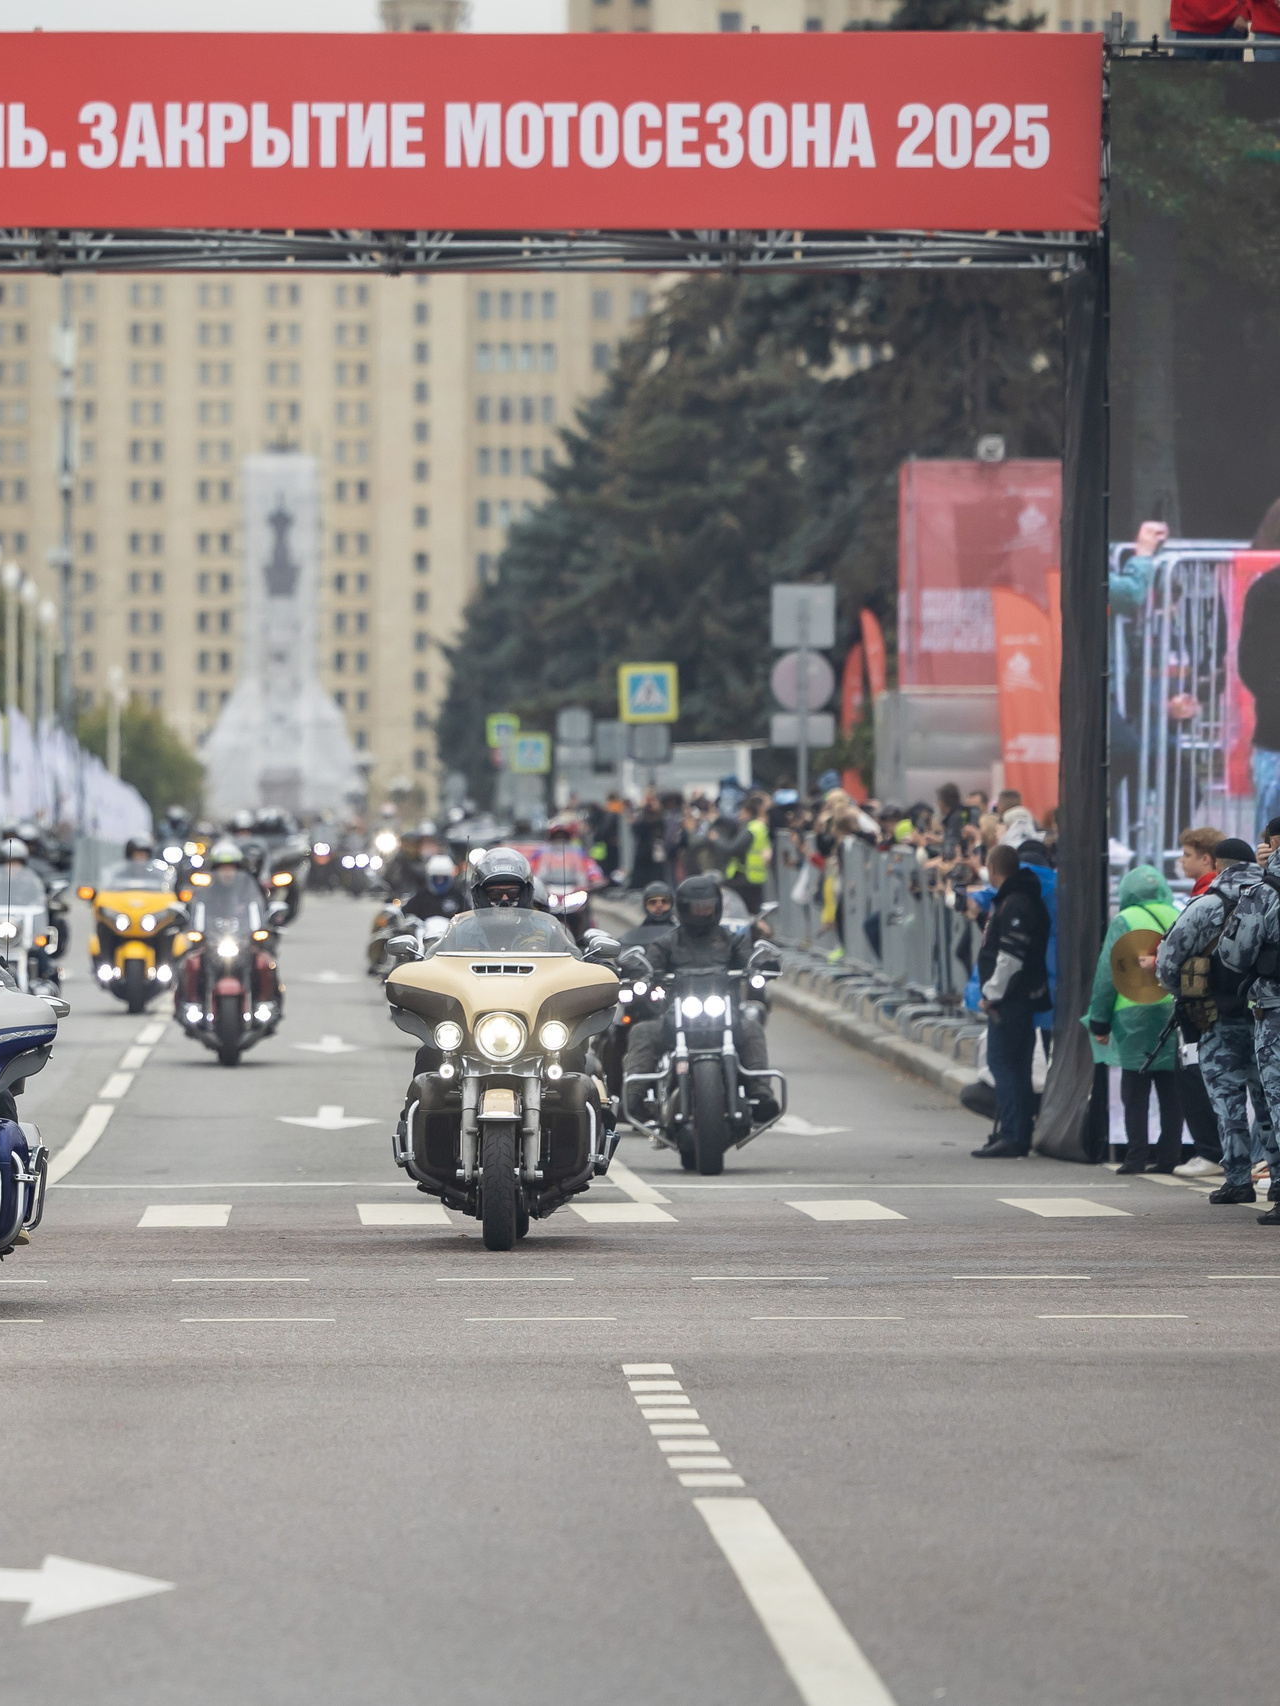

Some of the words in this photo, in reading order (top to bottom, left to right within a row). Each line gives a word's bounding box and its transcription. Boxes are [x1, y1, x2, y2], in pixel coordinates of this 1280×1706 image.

[78, 101, 426, 169] ЗАКРЫТИЕ
[444, 101, 876, 169] МОТОСЕЗОНА
[896, 103, 1050, 169] 2025
